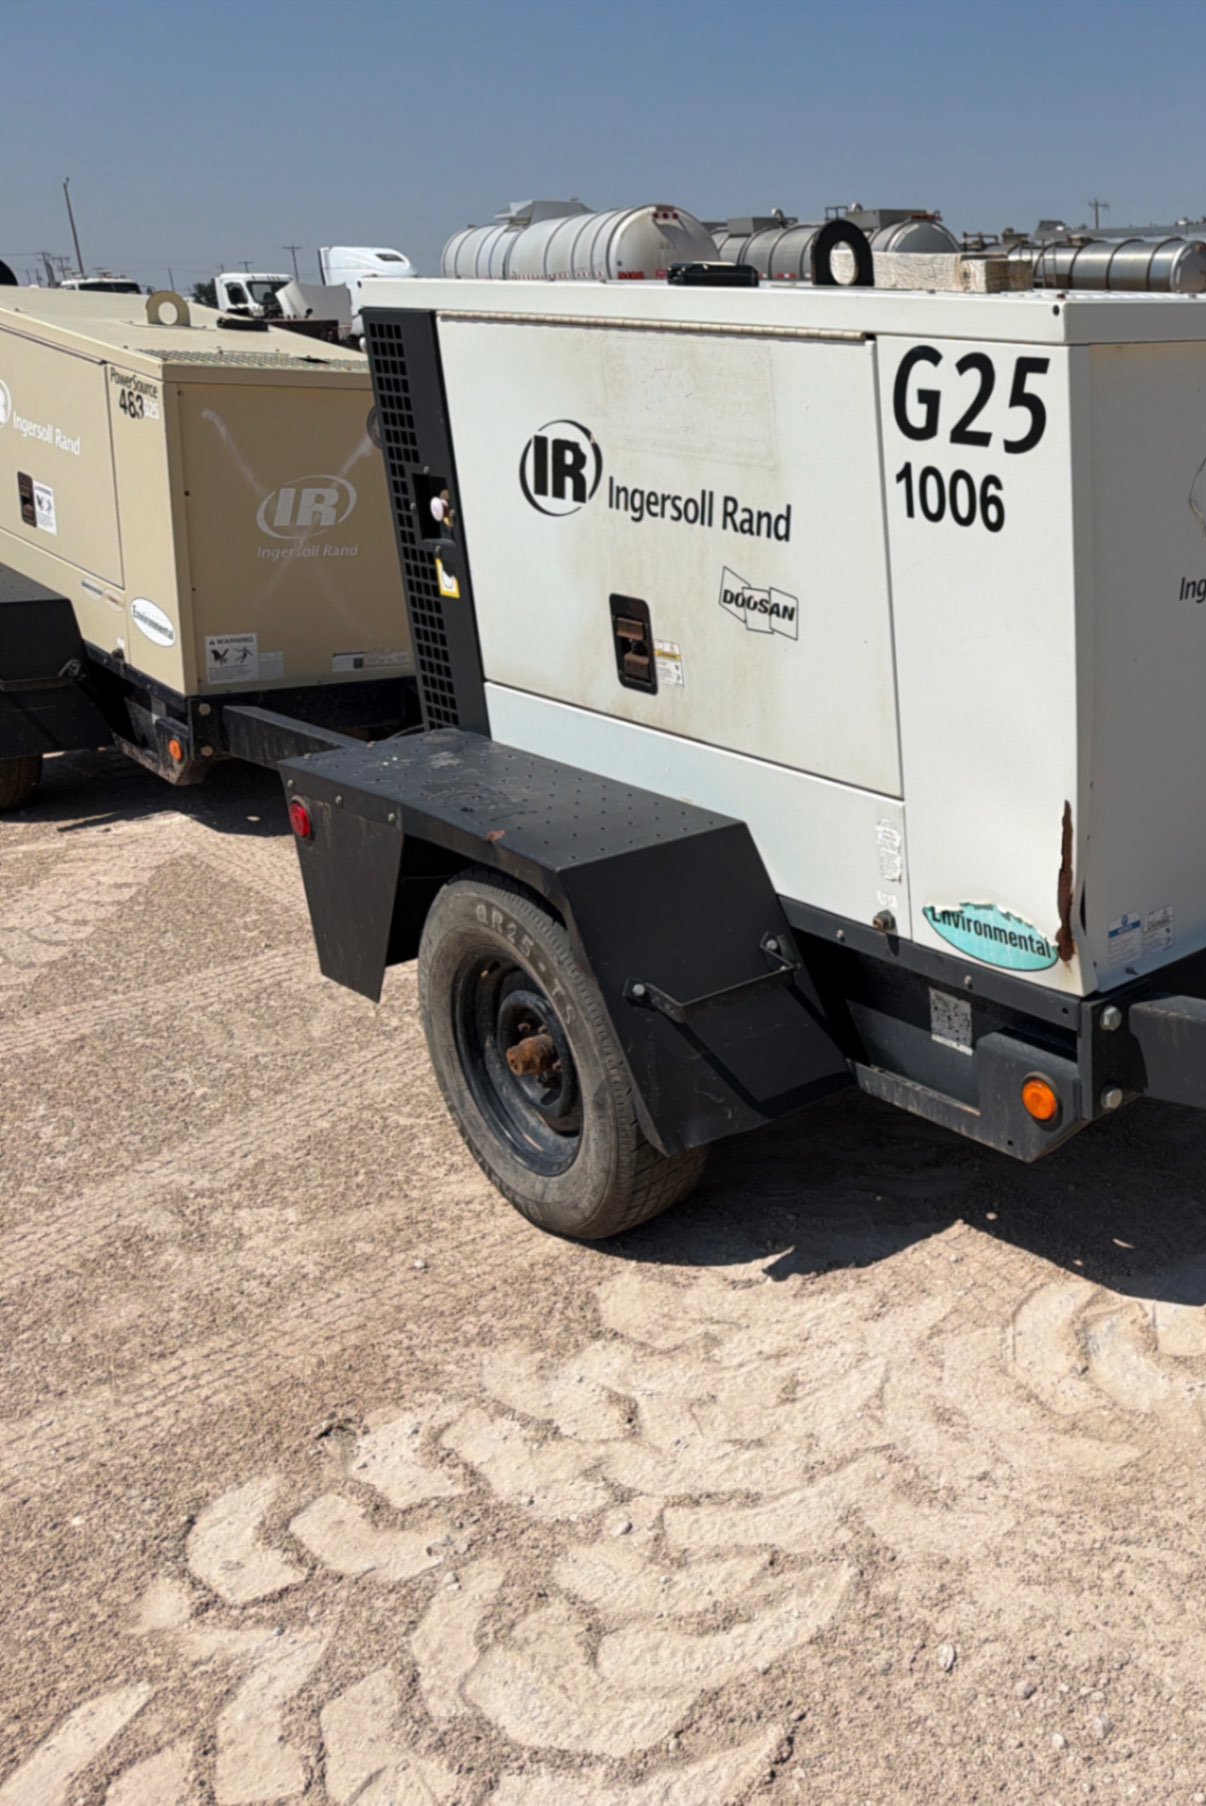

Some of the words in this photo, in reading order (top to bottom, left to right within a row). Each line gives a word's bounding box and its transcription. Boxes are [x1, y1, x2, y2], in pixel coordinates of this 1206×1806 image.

[110, 366, 158, 399] PowerSource
[893, 345, 1050, 455] G25
[13, 410, 53, 444] Ingersoll
[55, 427, 80, 455] Rand
[533, 434, 587, 504] IR
[273, 487, 340, 527] IR
[608, 475, 713, 528] Ingersoll
[722, 495, 791, 542] Rand
[895, 461, 1005, 533] 1006
[257, 544, 320, 562] Ingersoll
[323, 543, 359, 557] Rand
[722, 588, 795, 622] DOOSAN
[475, 903, 534, 957] QR25
